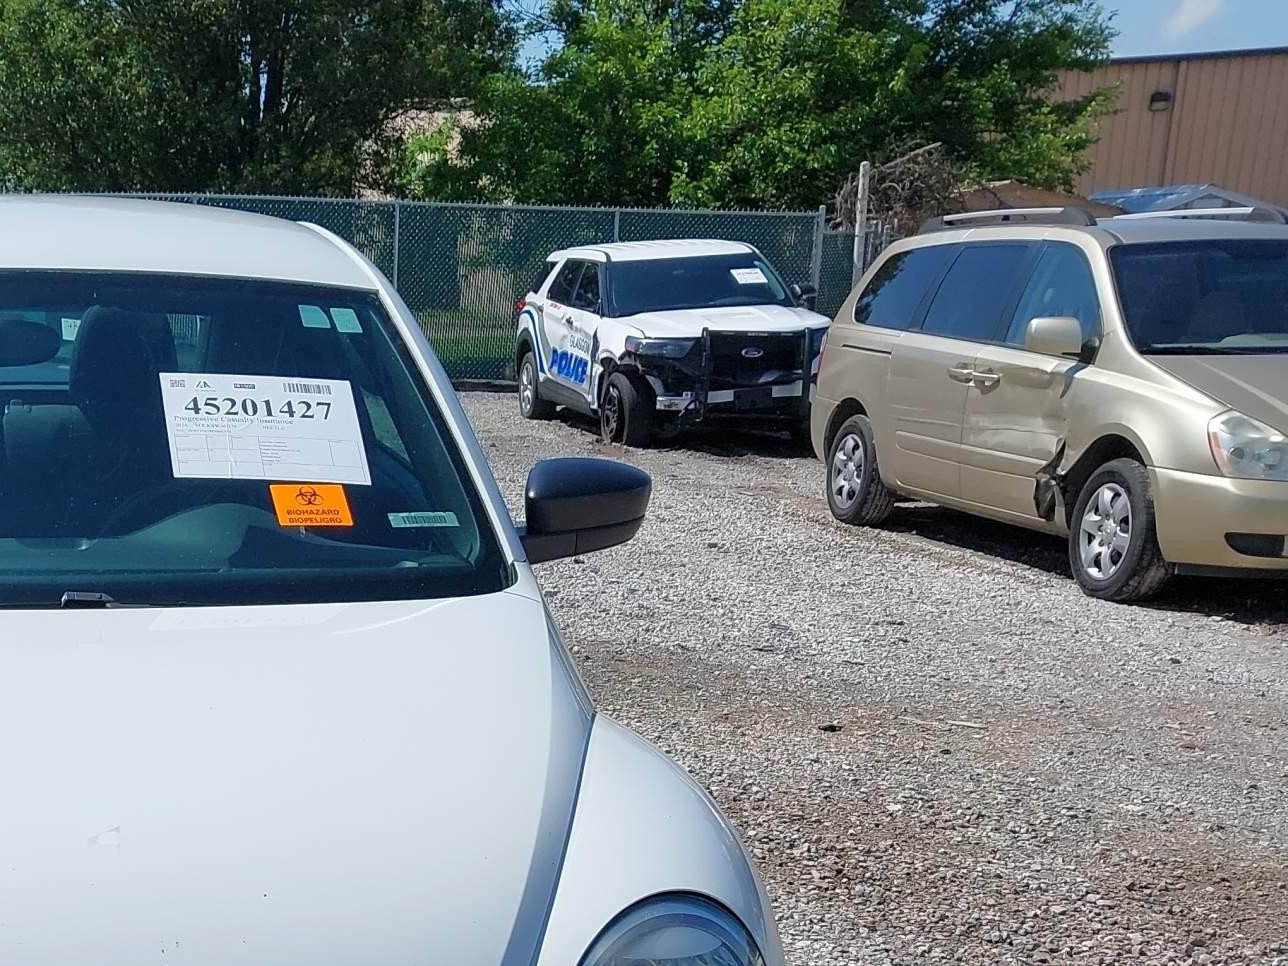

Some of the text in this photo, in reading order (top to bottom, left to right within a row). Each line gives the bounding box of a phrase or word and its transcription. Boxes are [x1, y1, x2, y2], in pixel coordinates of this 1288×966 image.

[549, 347, 589, 385] POLICE
[174, 415, 294, 425] Progressive Casualty Insurance
[184, 396, 332, 420] 45201427
